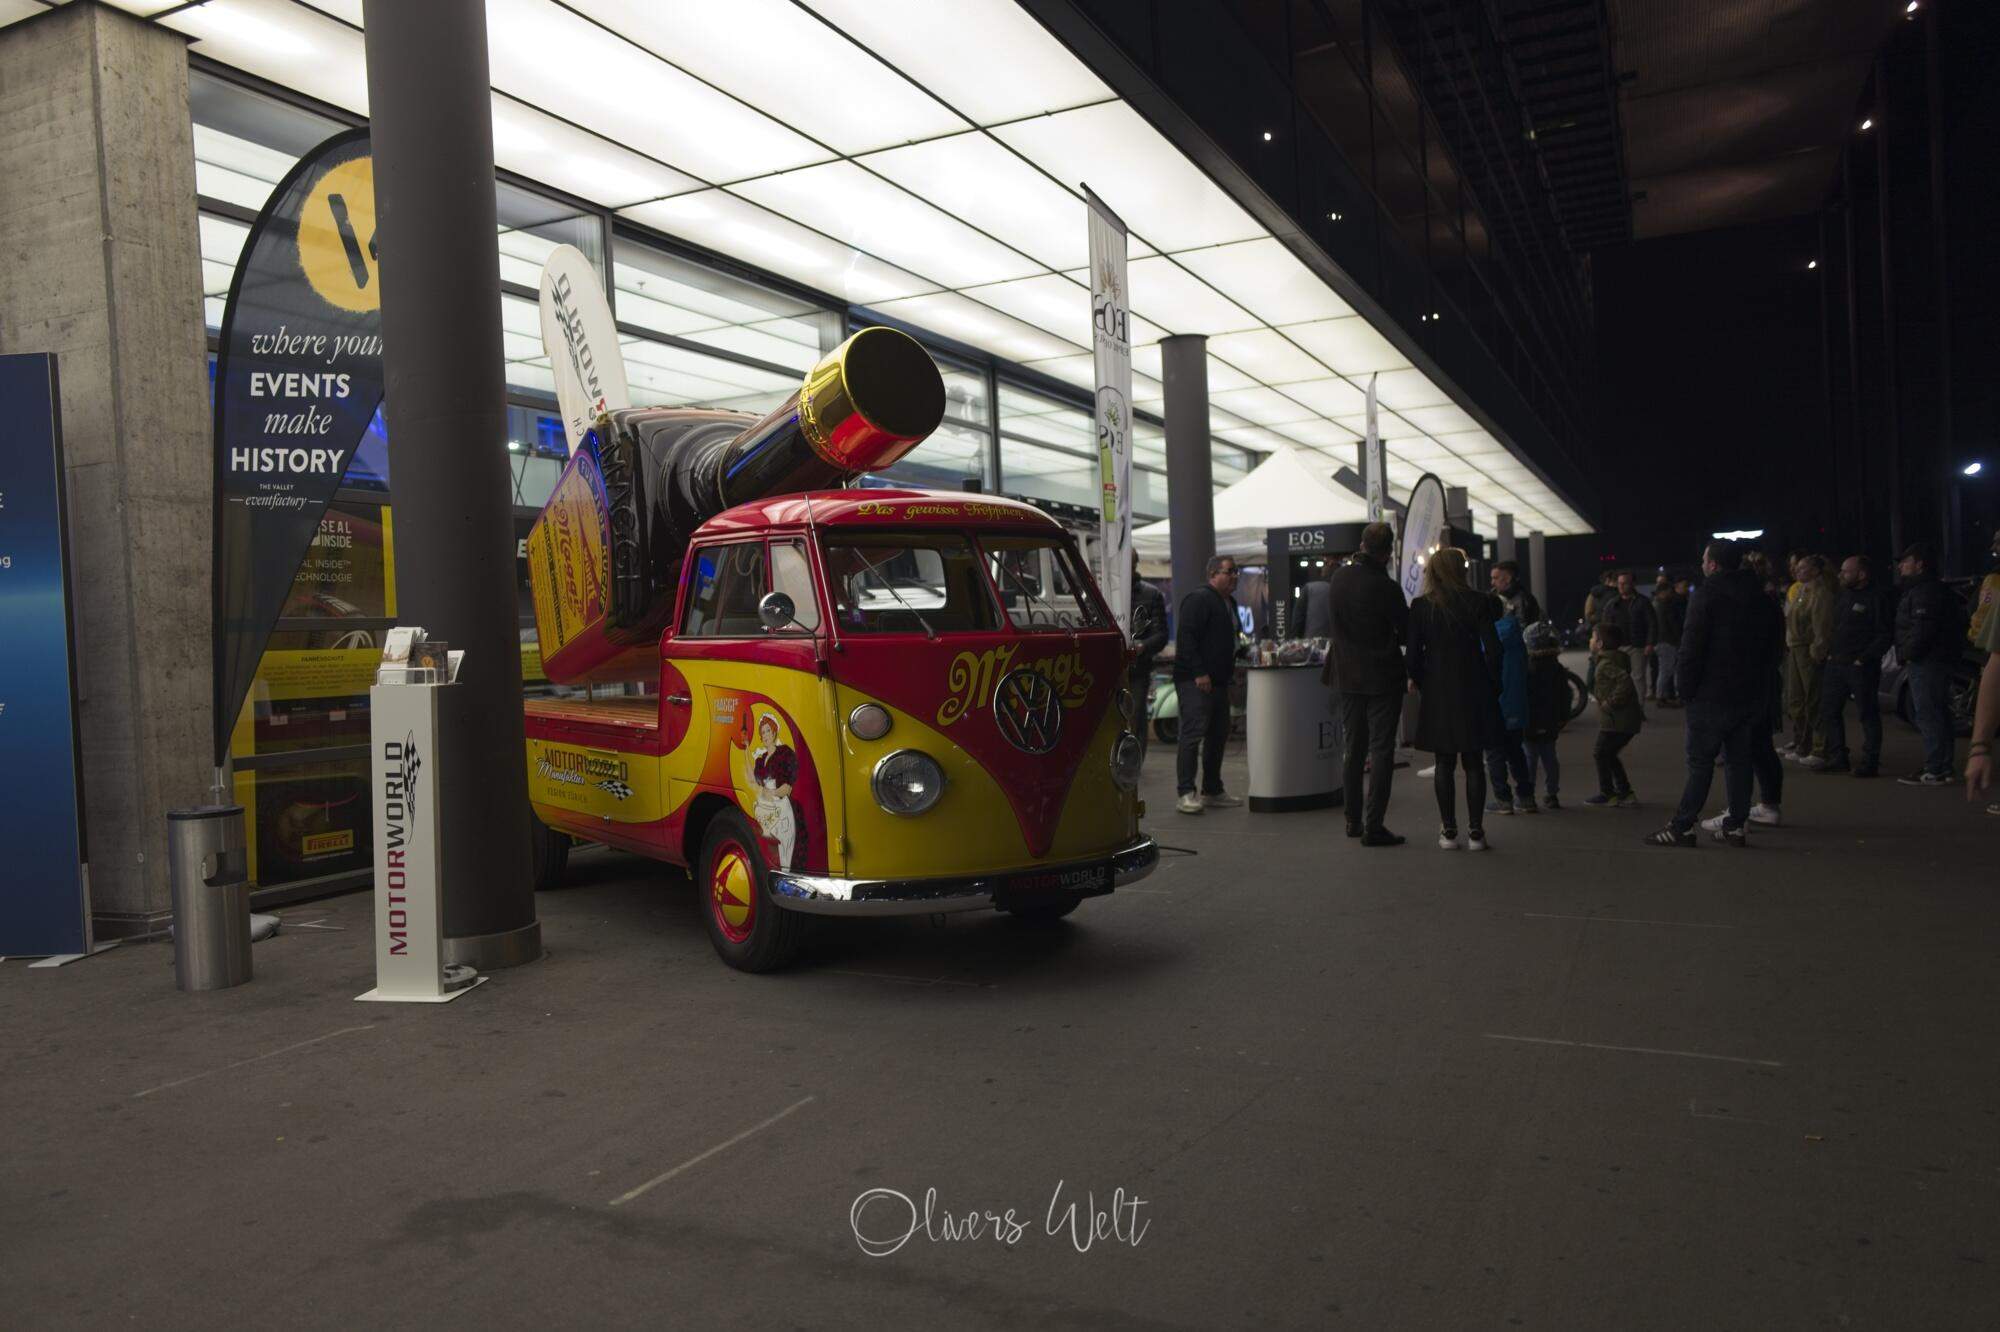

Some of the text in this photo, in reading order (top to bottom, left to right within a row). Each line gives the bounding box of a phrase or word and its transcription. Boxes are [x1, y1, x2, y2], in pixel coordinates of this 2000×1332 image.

[252, 325, 326, 355] where
[250, 372, 351, 398] EVENTS
[263, 405, 333, 434] make
[231, 447, 345, 473] HISTORY
[245, 493, 308, 510] eventfactory
[857, 502, 897, 517] Das
[320, 520, 352, 534] SEAL
[321, 534, 353, 548] INSIDE
[1288, 530, 1325, 546] EOS
[307, 834, 350, 851] PIRELLI
[385, 742, 408, 955] MOTORWORLD
[1008, 866, 1105, 891] MOTORWORLD
